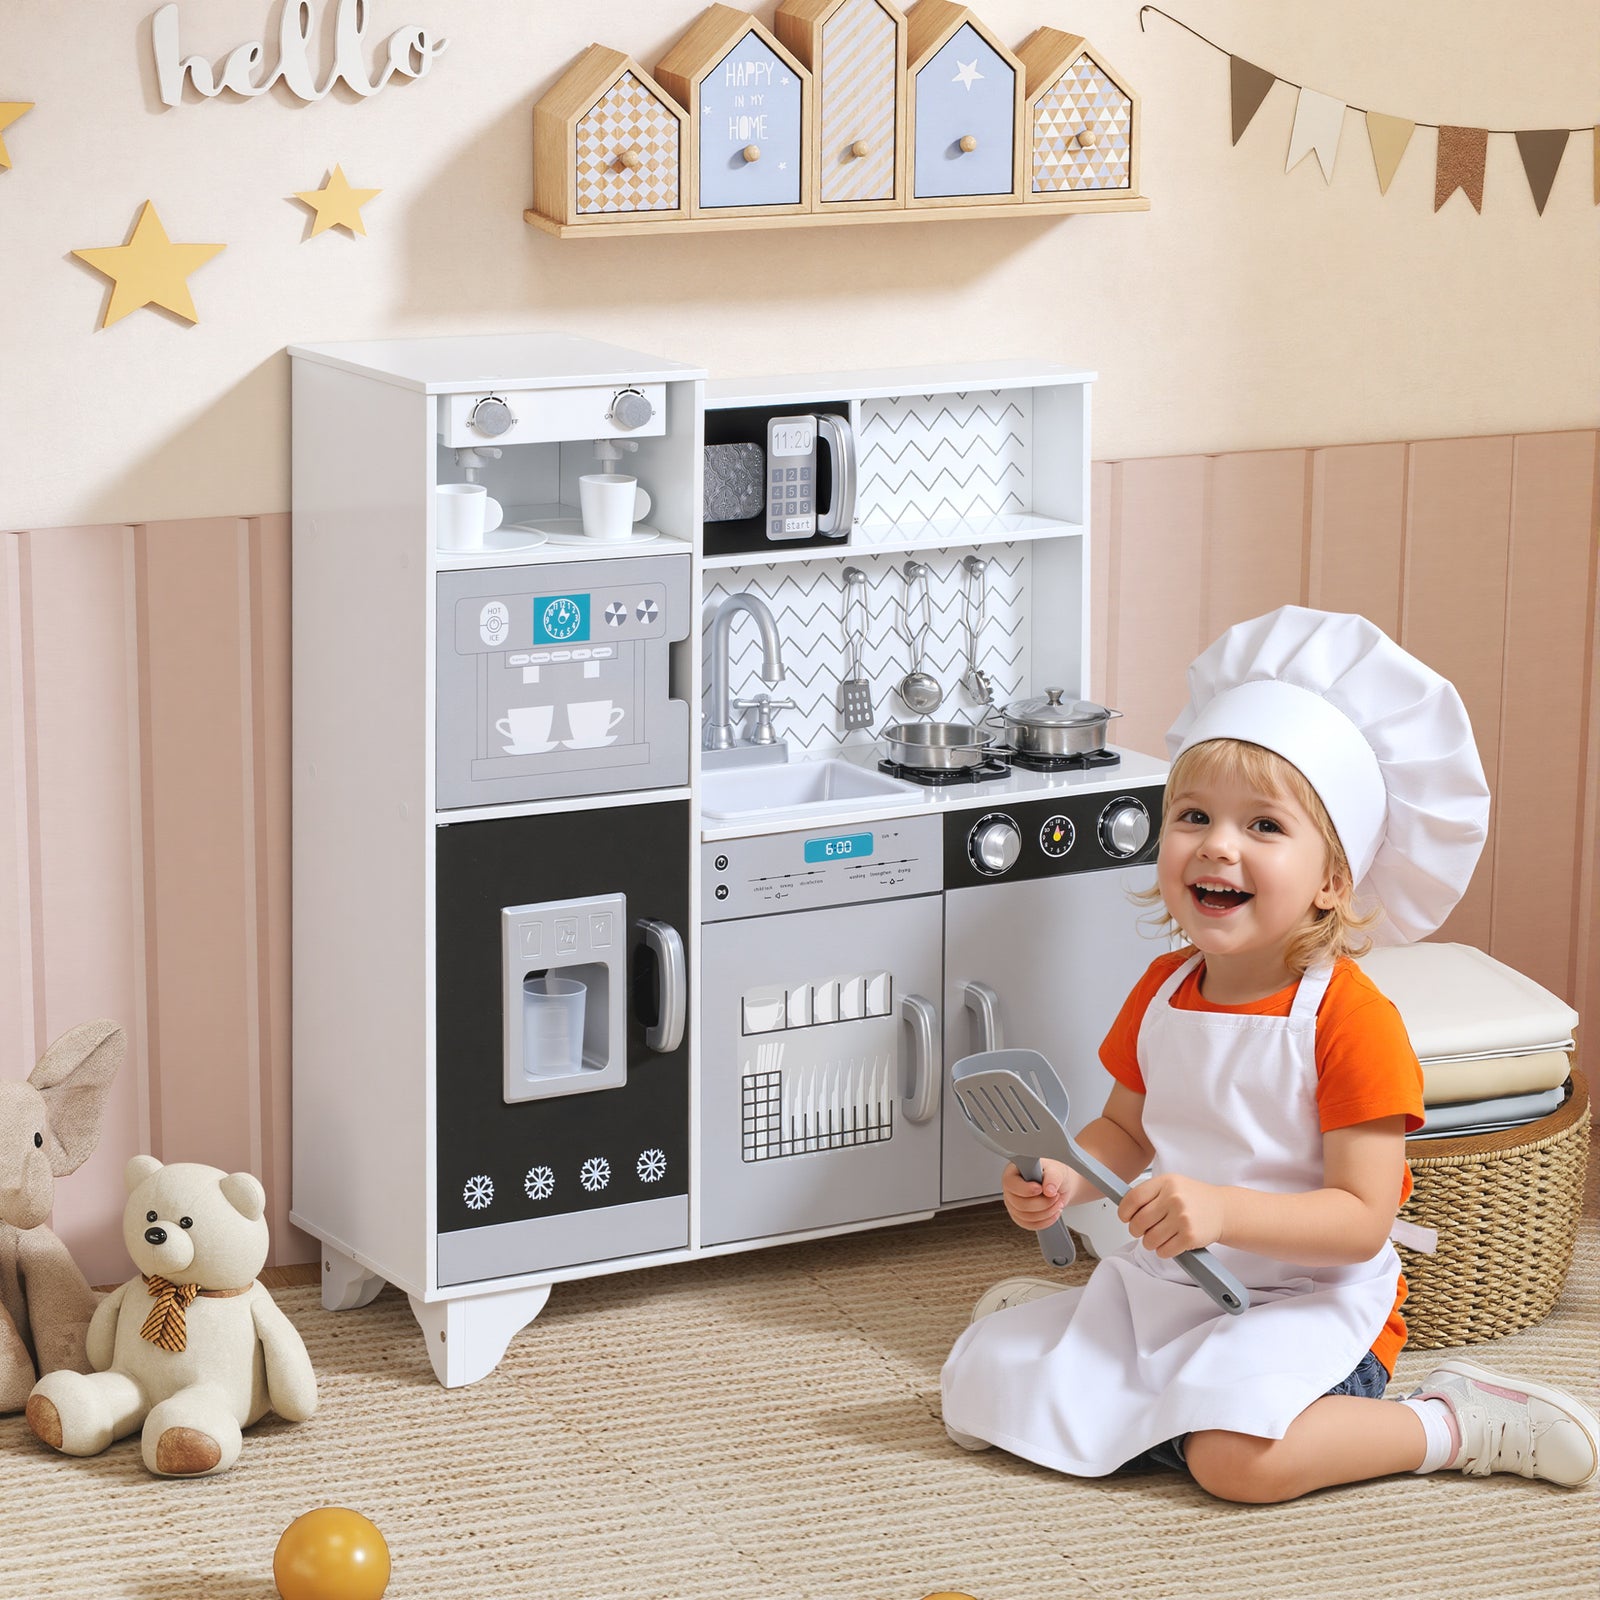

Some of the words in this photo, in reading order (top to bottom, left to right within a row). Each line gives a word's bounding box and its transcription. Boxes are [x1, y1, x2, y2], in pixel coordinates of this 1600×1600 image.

[153, 0, 449, 107] hello
[725, 61, 775, 87] HAPPY
[734, 94, 744, 108] IN
[750, 94, 764, 106] MY
[728, 114, 769, 141] HOME
[774, 430, 811, 450] 11:20
[786, 520, 810, 530] start
[487, 607, 501, 615] HOT
[488, 634, 501, 642] ICE
[825, 840, 852, 856] 6:00
